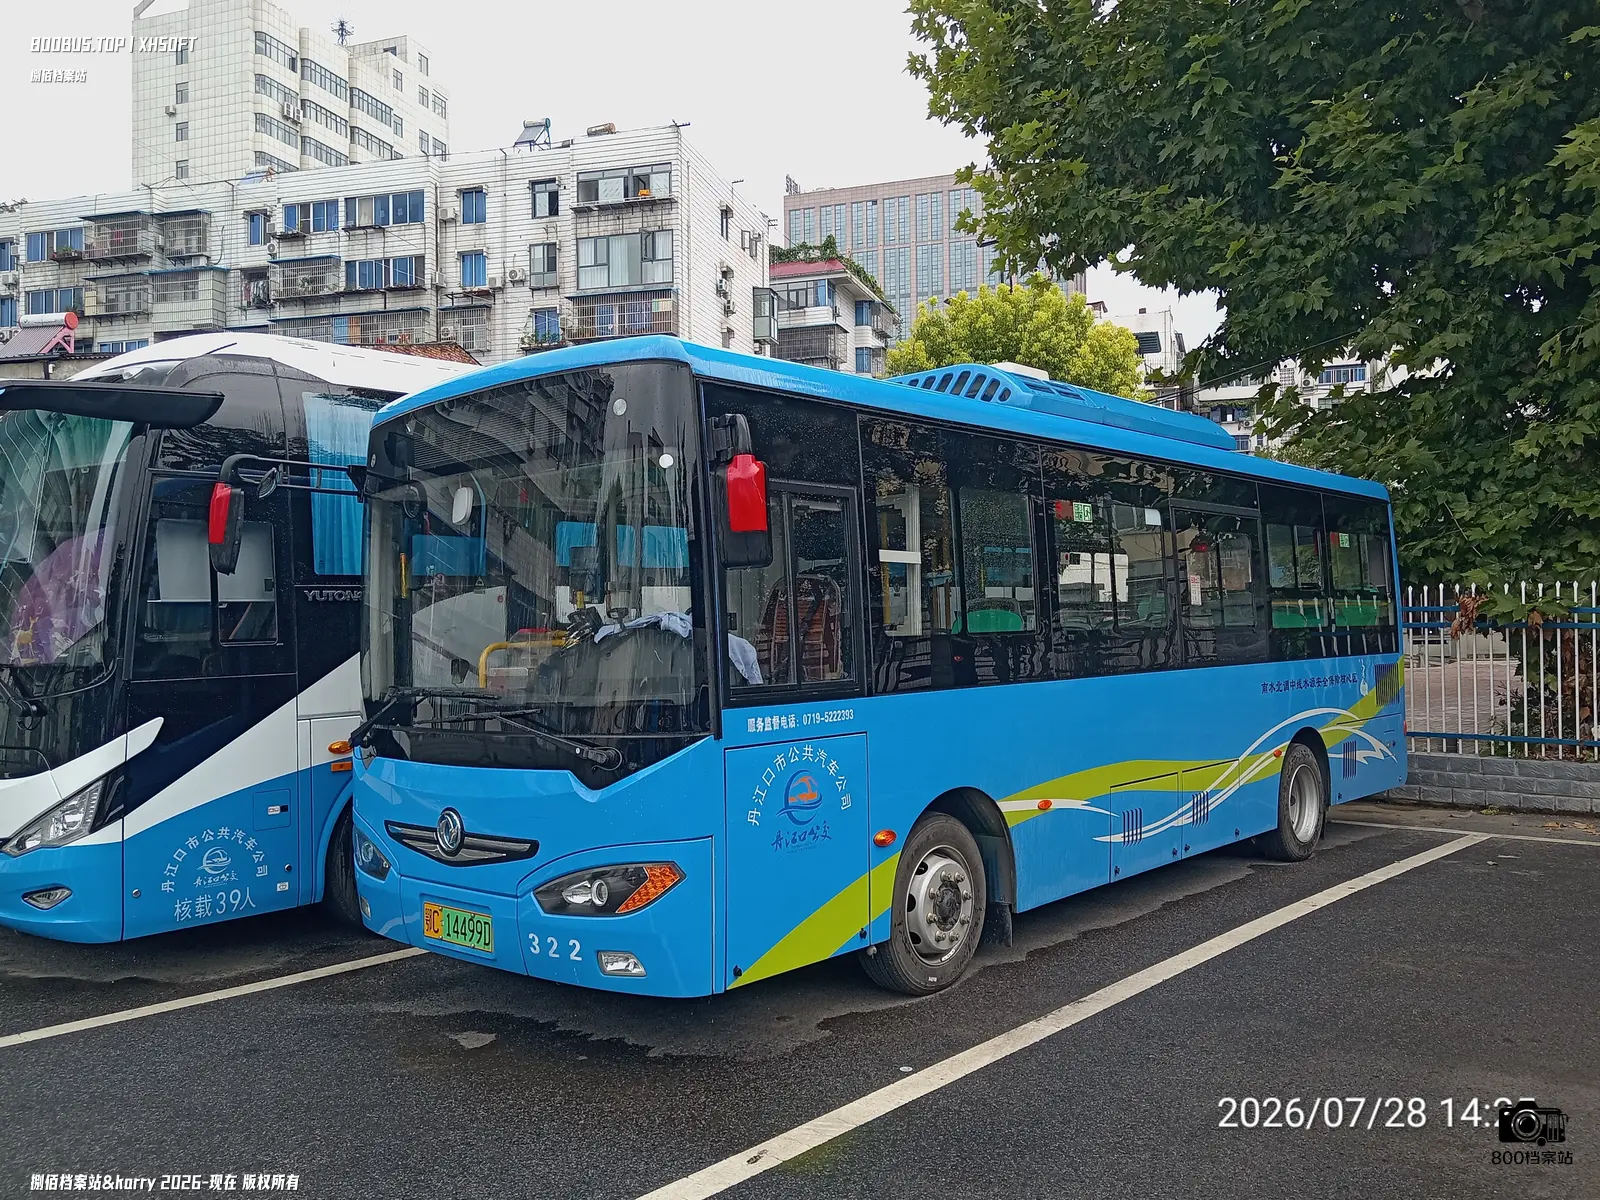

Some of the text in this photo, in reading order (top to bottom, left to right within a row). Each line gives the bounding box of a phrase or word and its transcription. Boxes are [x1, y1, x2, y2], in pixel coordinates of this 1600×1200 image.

[802, 709, 854, 726] 0719-5222393
[747, 744, 852, 827] 丹江口市公共汽车公司
[161, 826, 269, 893] 丹江口市公共汽车公司
[174, 887, 256, 922] 核载39人
